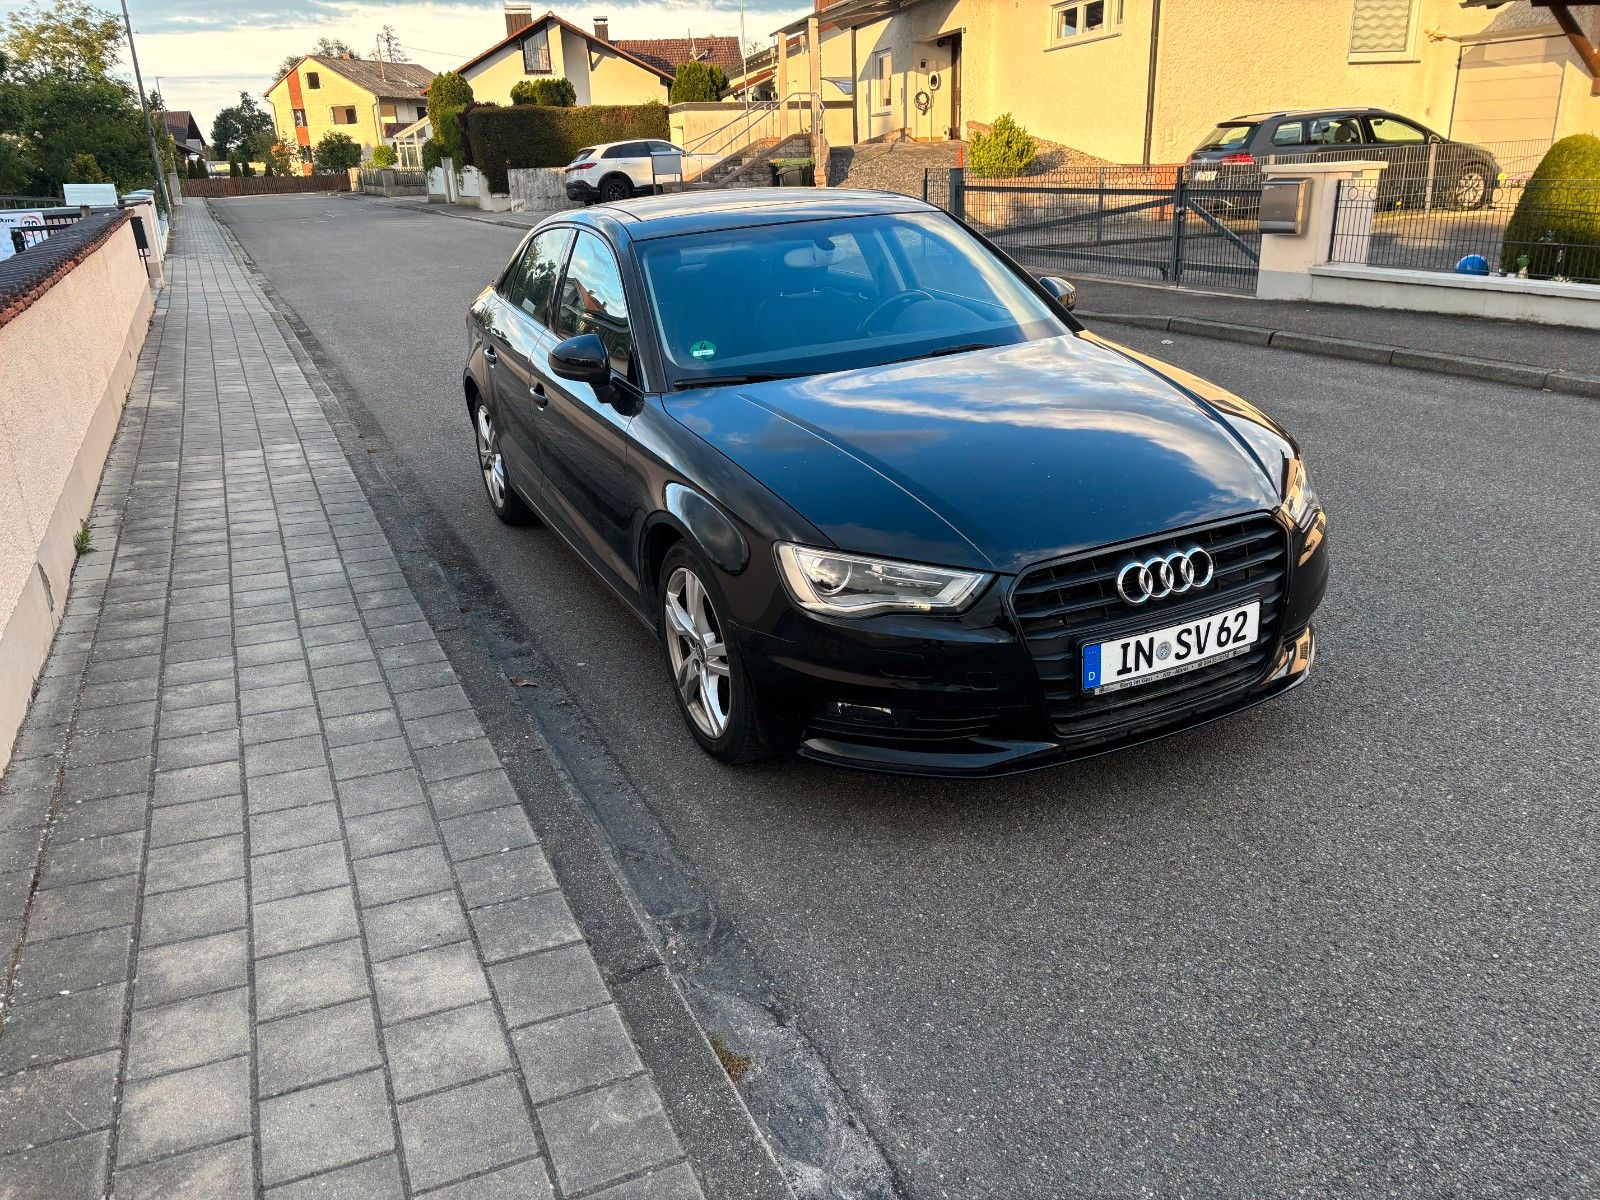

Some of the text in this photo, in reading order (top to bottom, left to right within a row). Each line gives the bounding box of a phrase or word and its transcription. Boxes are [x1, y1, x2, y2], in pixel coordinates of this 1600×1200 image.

[1116, 610, 1248, 676] IN SV 62
[1088, 671, 1096, 681] D
